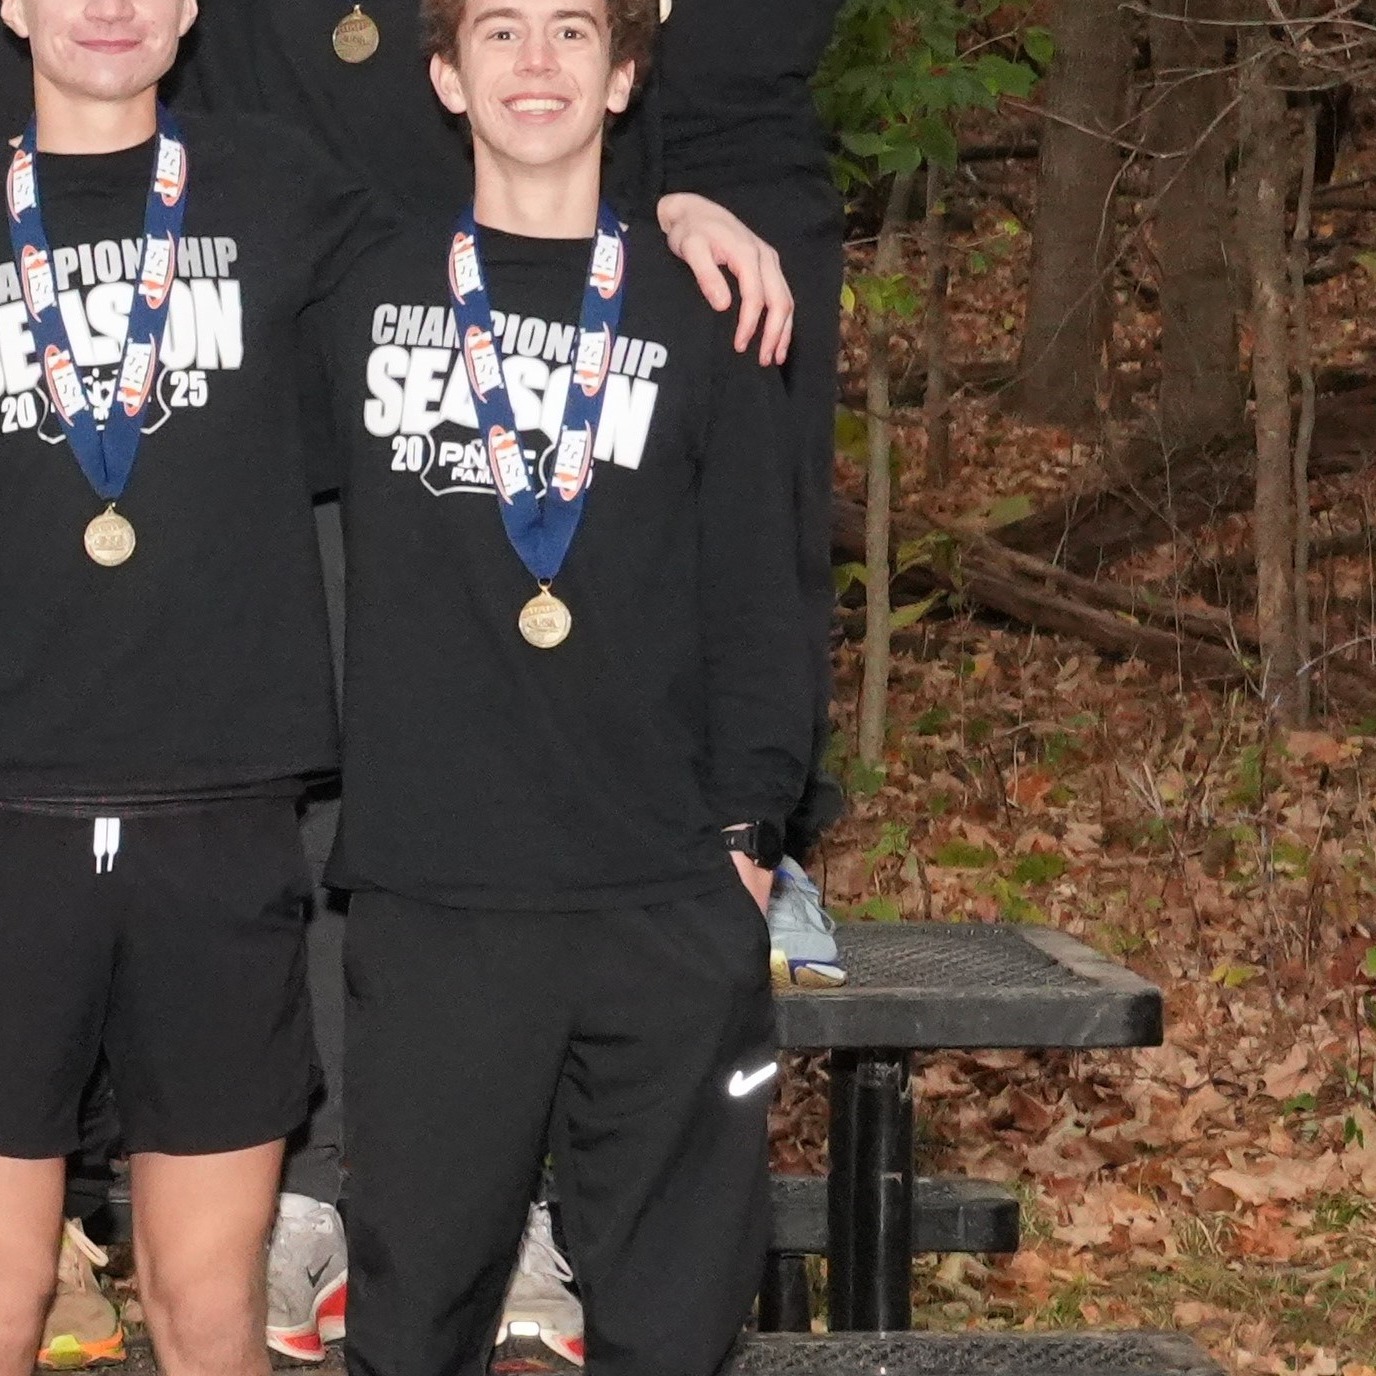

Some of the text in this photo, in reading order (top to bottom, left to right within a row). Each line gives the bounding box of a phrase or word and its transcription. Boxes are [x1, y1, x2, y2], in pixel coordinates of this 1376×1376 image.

[1, 392, 37, 433] 20
[169, 371, 208, 407] 25
[391, 436, 423, 472] 20
